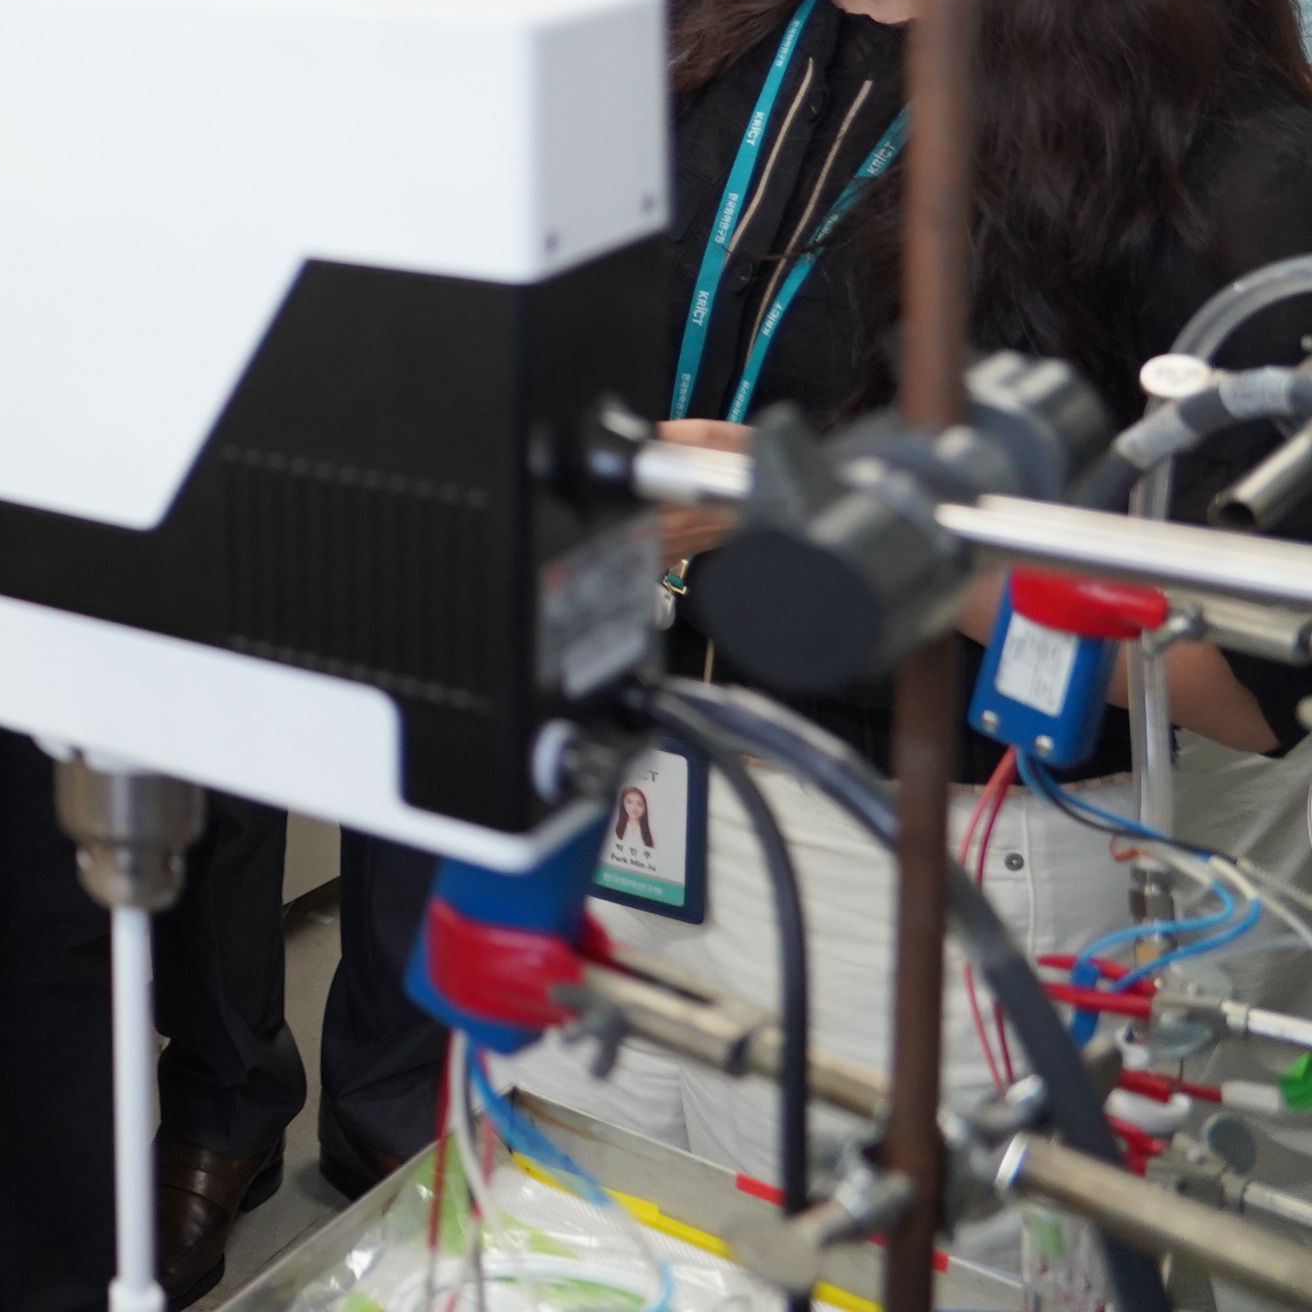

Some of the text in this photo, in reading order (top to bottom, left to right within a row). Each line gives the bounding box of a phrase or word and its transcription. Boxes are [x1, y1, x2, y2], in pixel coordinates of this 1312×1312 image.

[746, 111, 765, 147] KRICT
[866, 140, 896, 176] KRICT
[692, 289, 710, 327] KRICT
[761, 302, 783, 337] KRICT
[610, 852, 657, 872] Park Min Ju
